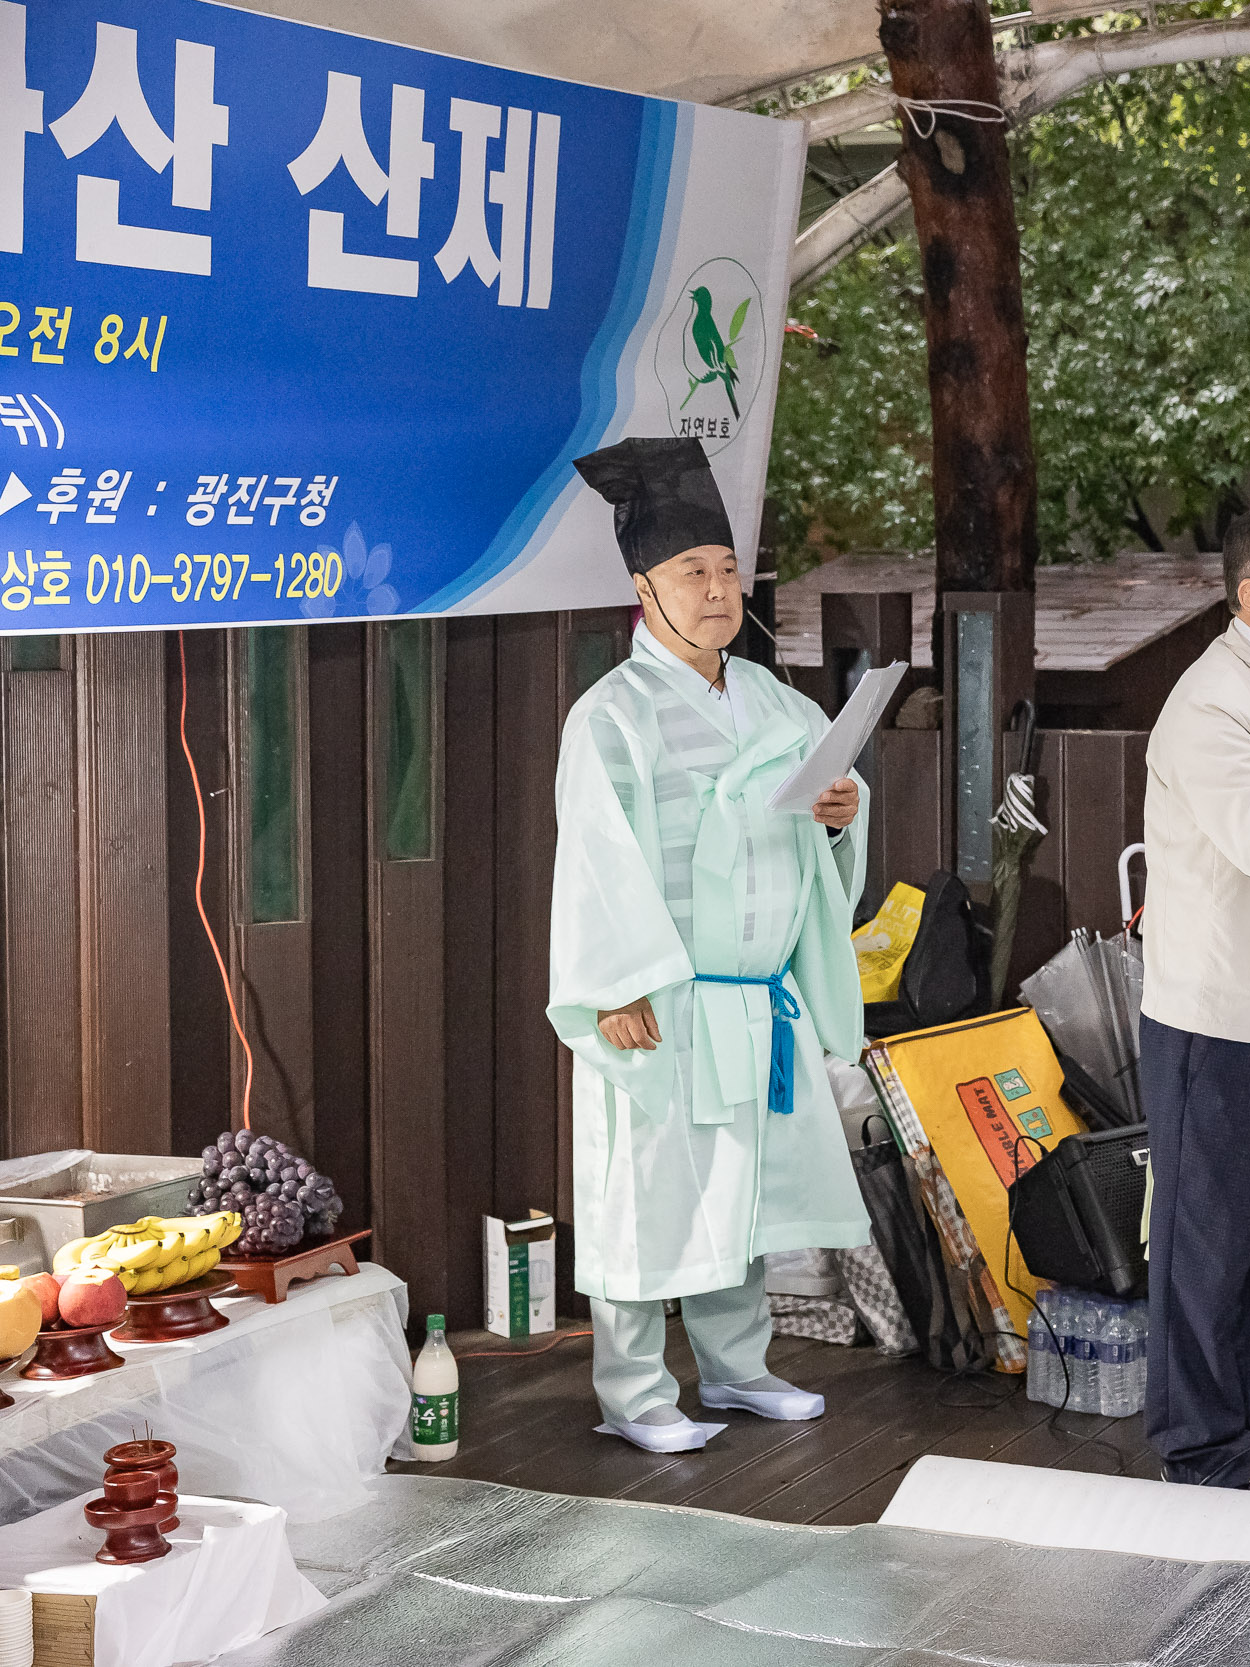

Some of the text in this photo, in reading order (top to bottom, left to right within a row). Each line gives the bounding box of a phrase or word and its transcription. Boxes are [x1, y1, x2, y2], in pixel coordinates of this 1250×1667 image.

[287, 70, 562, 310] 산제
[0, 301, 168, 373] 오전 8시
[679, 416, 730, 439] 자연보호
[36, 467, 133, 525] 후원
[185, 473, 339, 527] 광진구청
[0, 550, 343, 611] 상호 010-3797-1280
[973, 1086, 998, 1120] MAT
